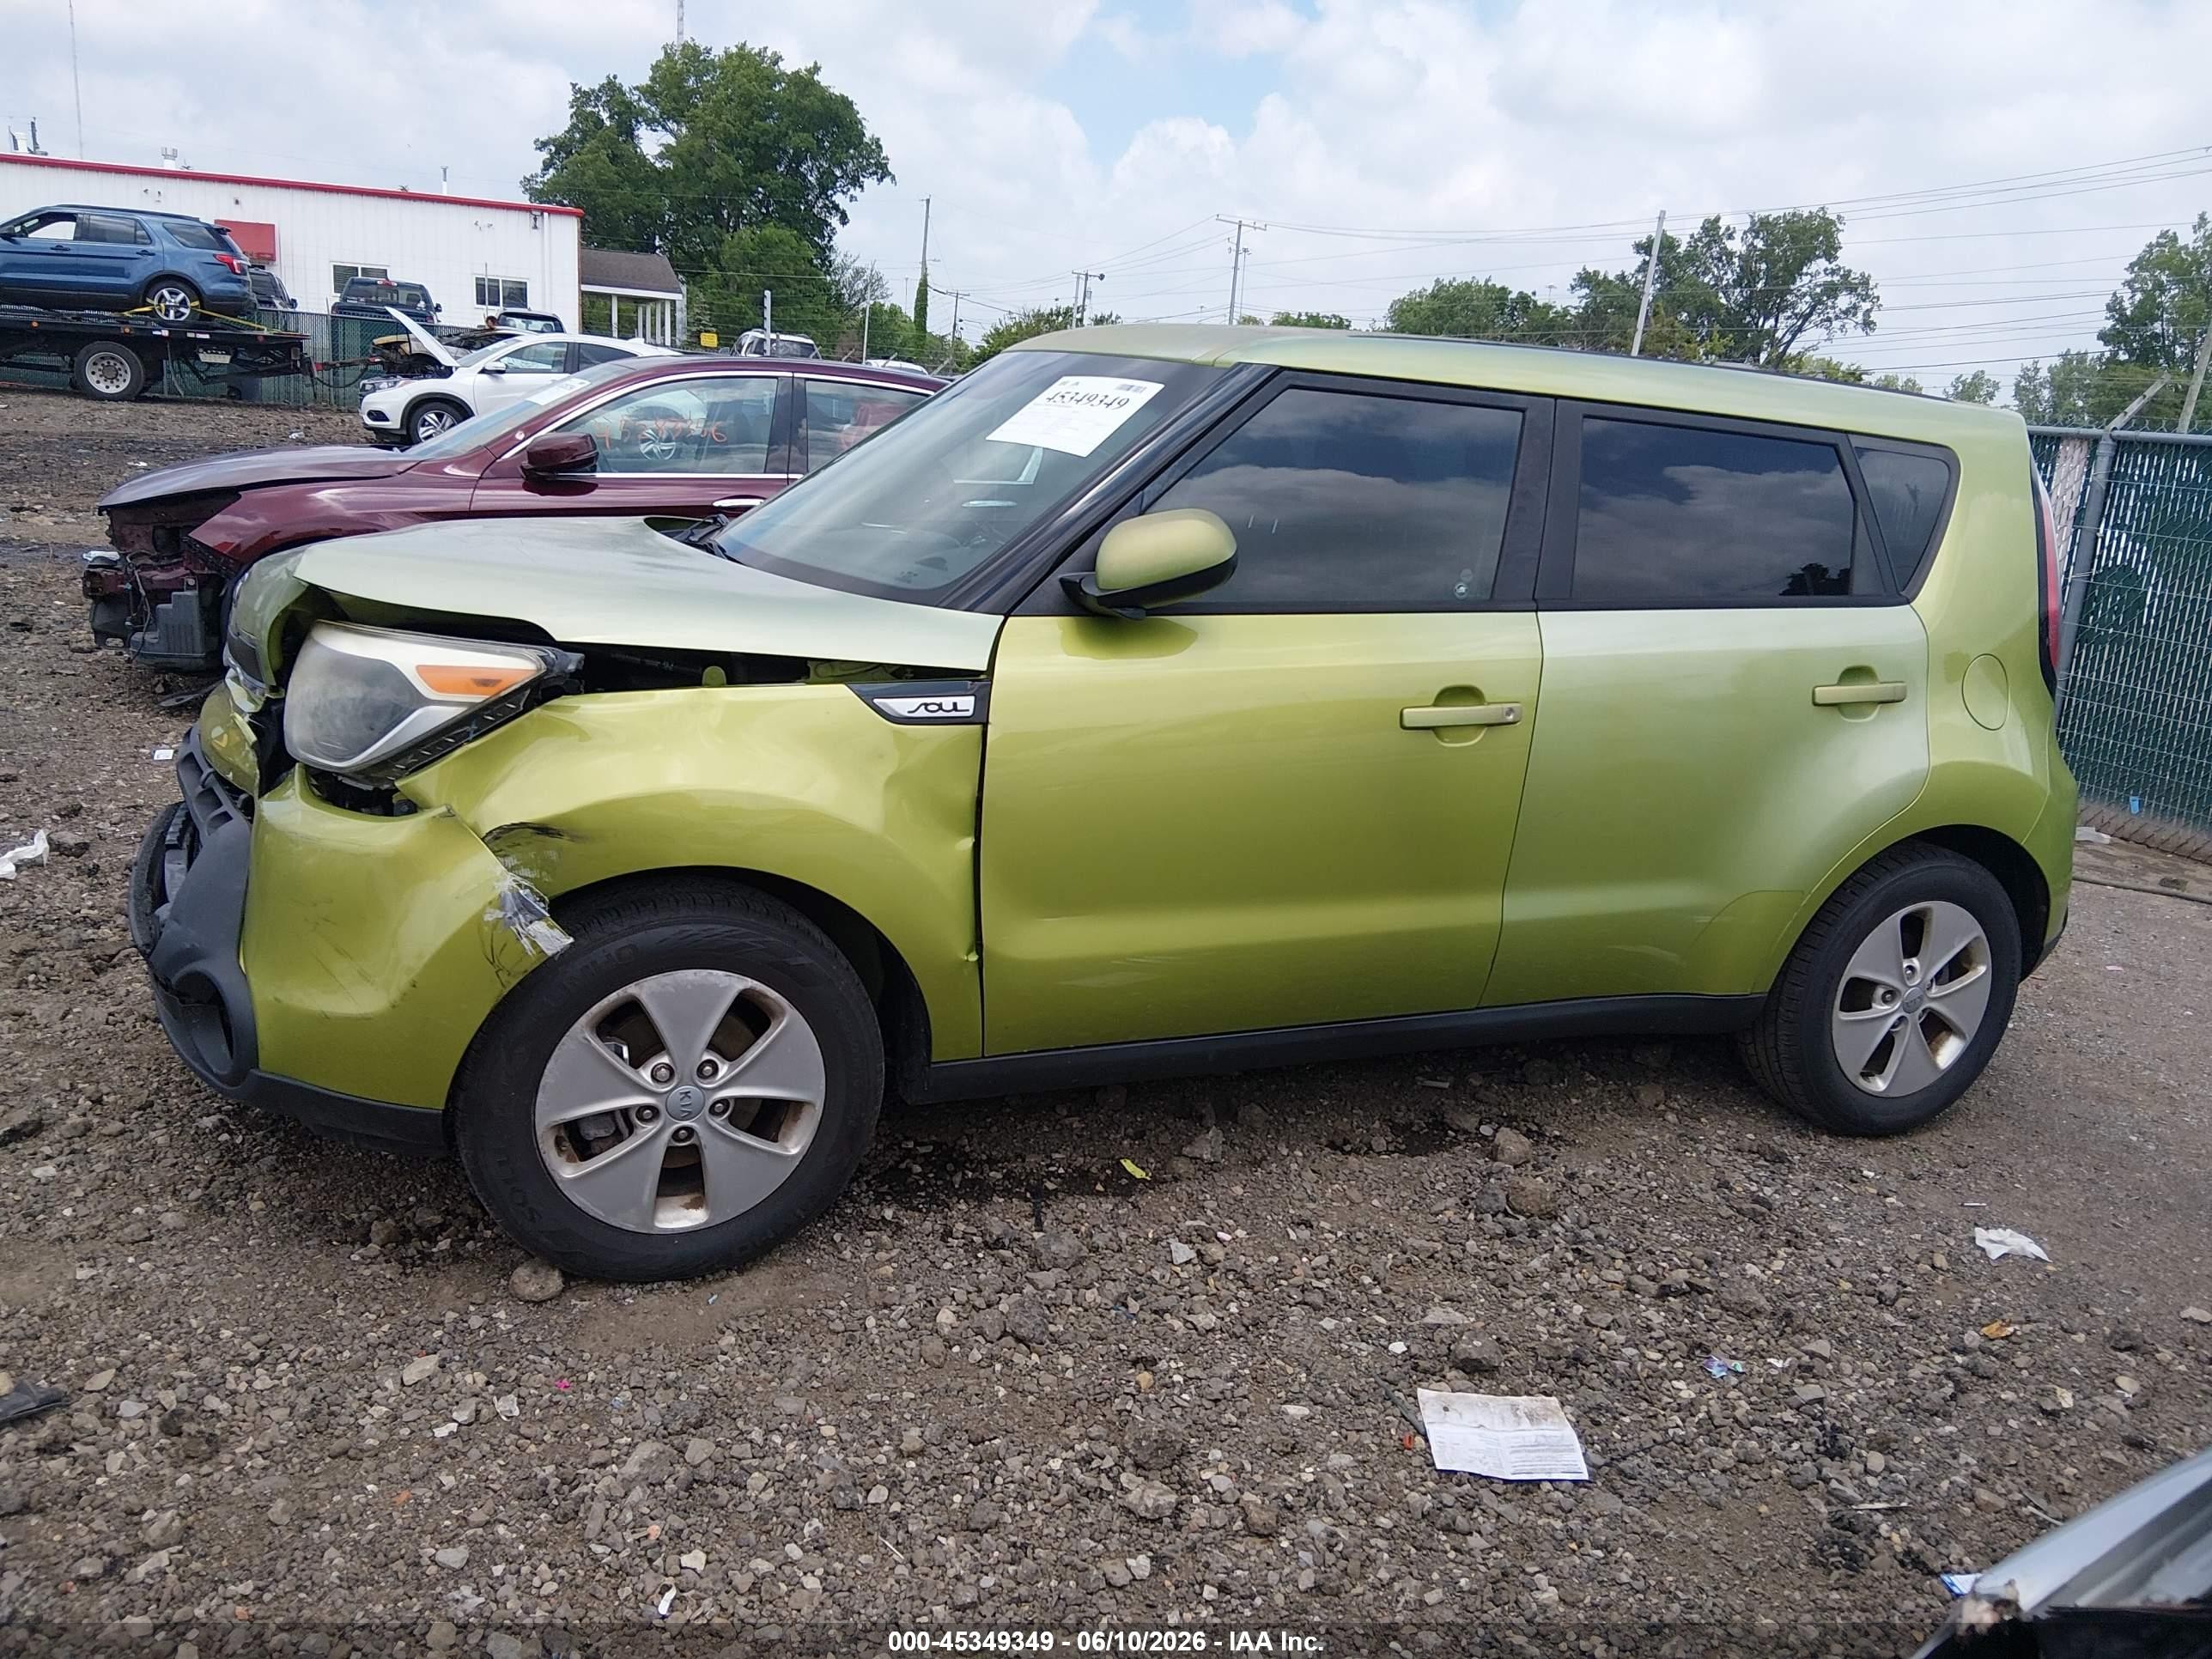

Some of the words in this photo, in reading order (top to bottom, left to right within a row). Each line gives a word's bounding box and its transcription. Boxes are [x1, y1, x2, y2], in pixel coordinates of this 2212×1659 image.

[1045, 391, 1130, 410] 45349349
[907, 701, 970, 714] SOUL
[679, 1091, 693, 1119] KIA
